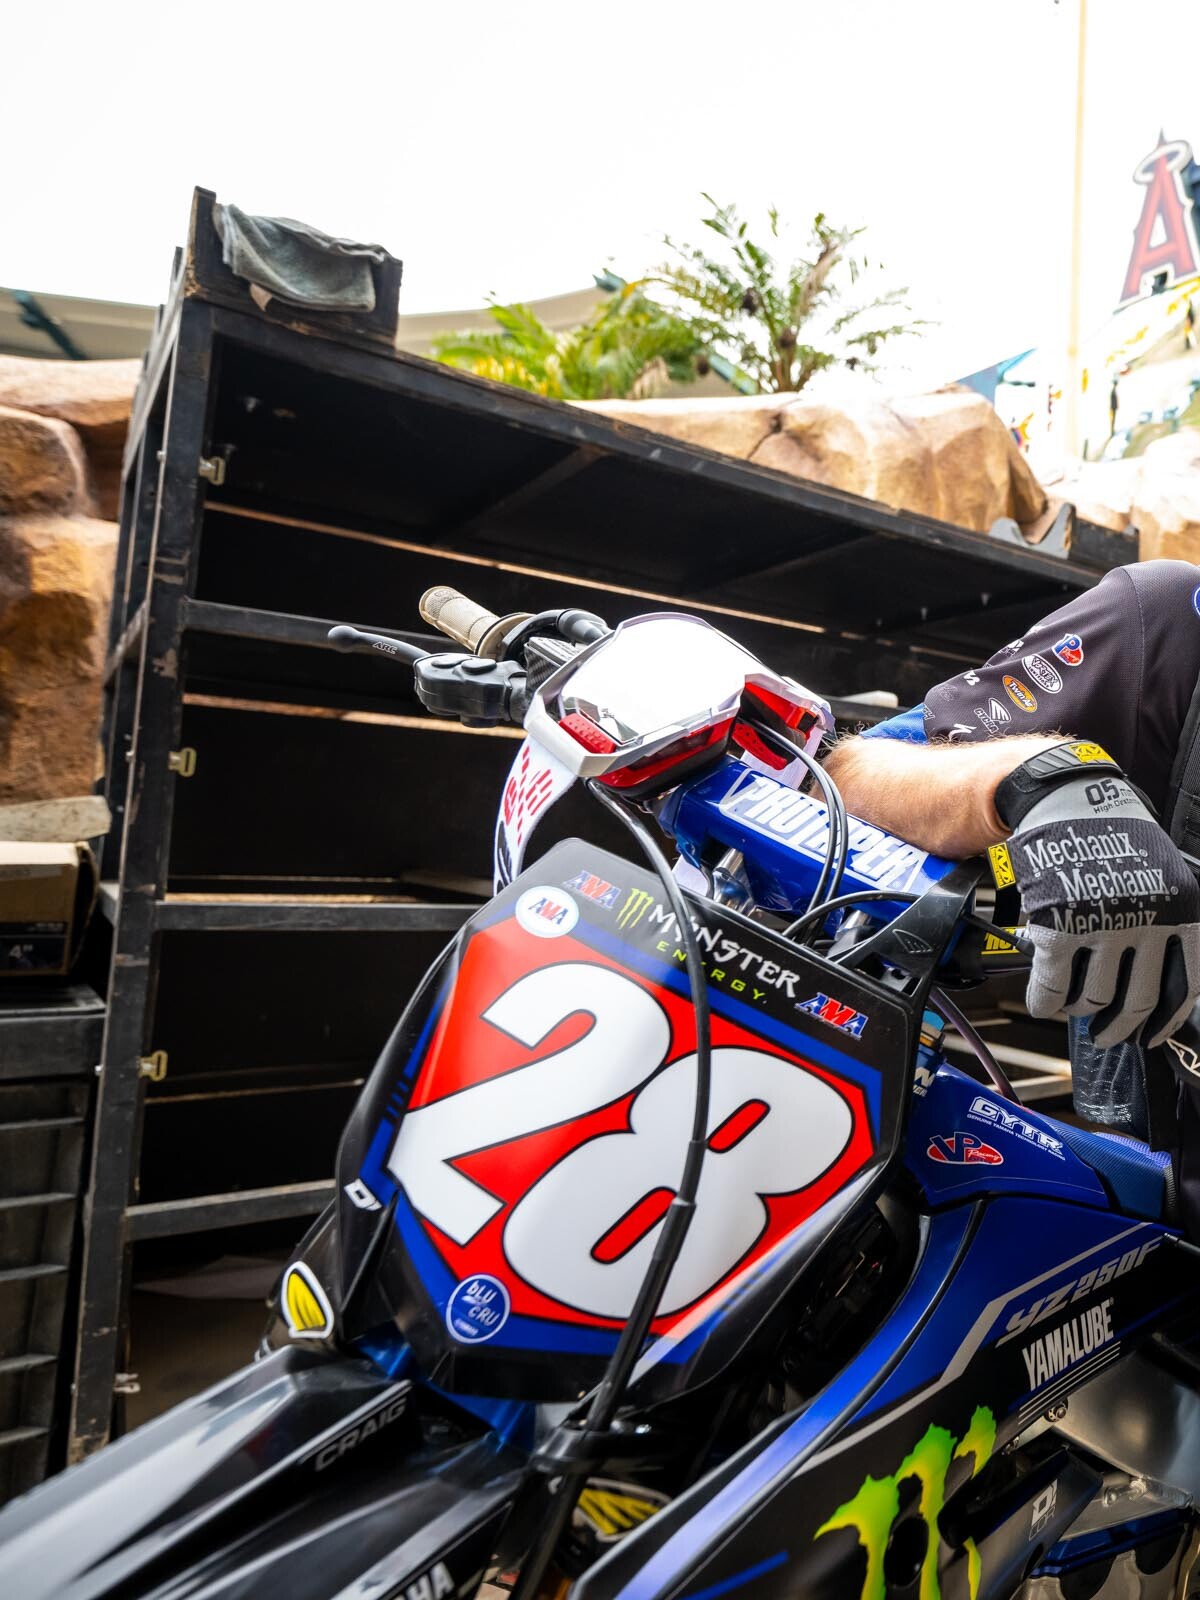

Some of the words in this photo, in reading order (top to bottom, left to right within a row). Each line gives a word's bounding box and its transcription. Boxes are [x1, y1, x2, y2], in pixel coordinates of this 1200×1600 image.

[1093, 803, 1114, 815] High
[1024, 826, 1139, 874] Mechanix
[562, 870, 622, 911] AMA
[1056, 859, 1170, 902] Mechanix
[527, 897, 570, 926] AMA
[655, 940, 766, 1002] ENRGY
[794, 992, 869, 1041] AMA
[387, 960, 854, 1319] 28
[930, 1131, 982, 1163] VP
[967, 1113, 993, 1126] GENUINE
[993, 1122, 1015, 1136] YAMAHA
[969, 1096, 1063, 1156] GYTR
[1022, 1299, 1114, 1392] YAMALUBE
[315, 1396, 408, 1472] CRAIG
